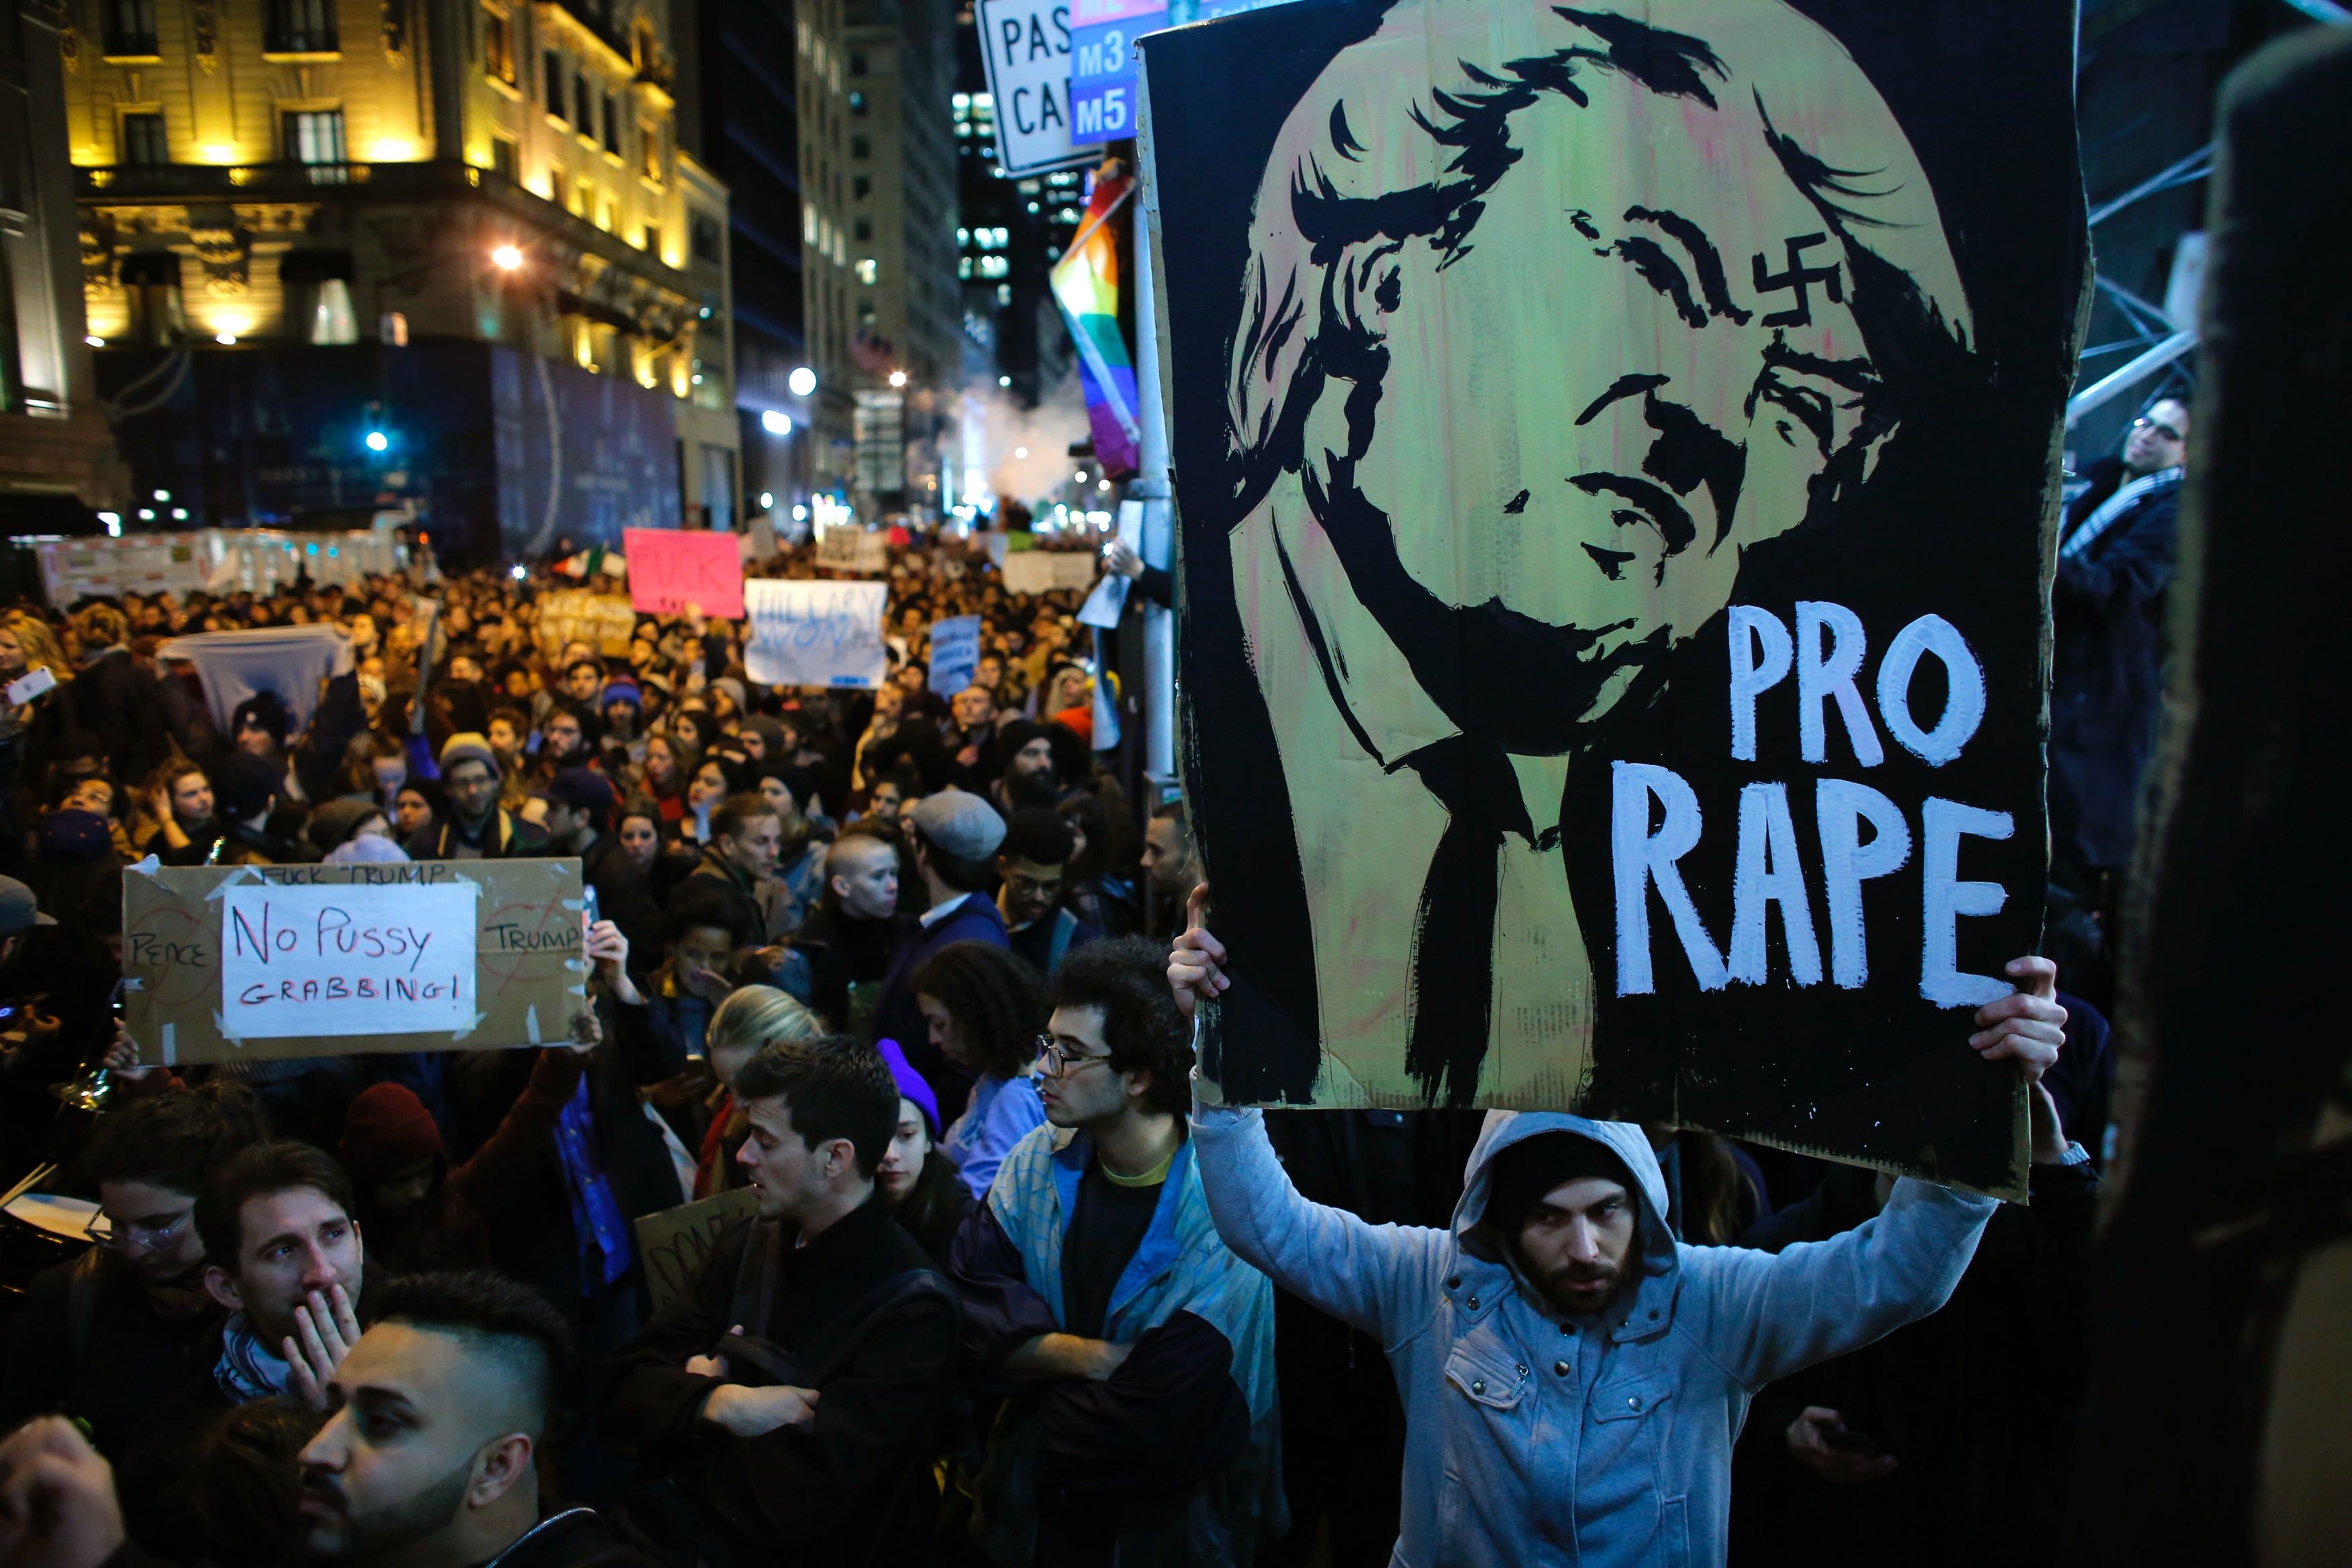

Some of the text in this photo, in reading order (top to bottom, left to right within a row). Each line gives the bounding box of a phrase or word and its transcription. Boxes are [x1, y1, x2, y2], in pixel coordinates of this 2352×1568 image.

[1079, 30, 1125, 77] M3
[1014, 78, 1071, 134] CA
[1077, 88, 1127, 135] M5
[632, 544, 726, 593] FUCK
[1728, 601, 1986, 767] PRO
[260, 866, 326, 885] FUCK
[340, 865, 446, 885] TRUMP
[1611, 760, 2019, 1008] RAPE
[485, 923, 579, 950] TRUMP
[240, 975, 458, 1010] GRABBING!
